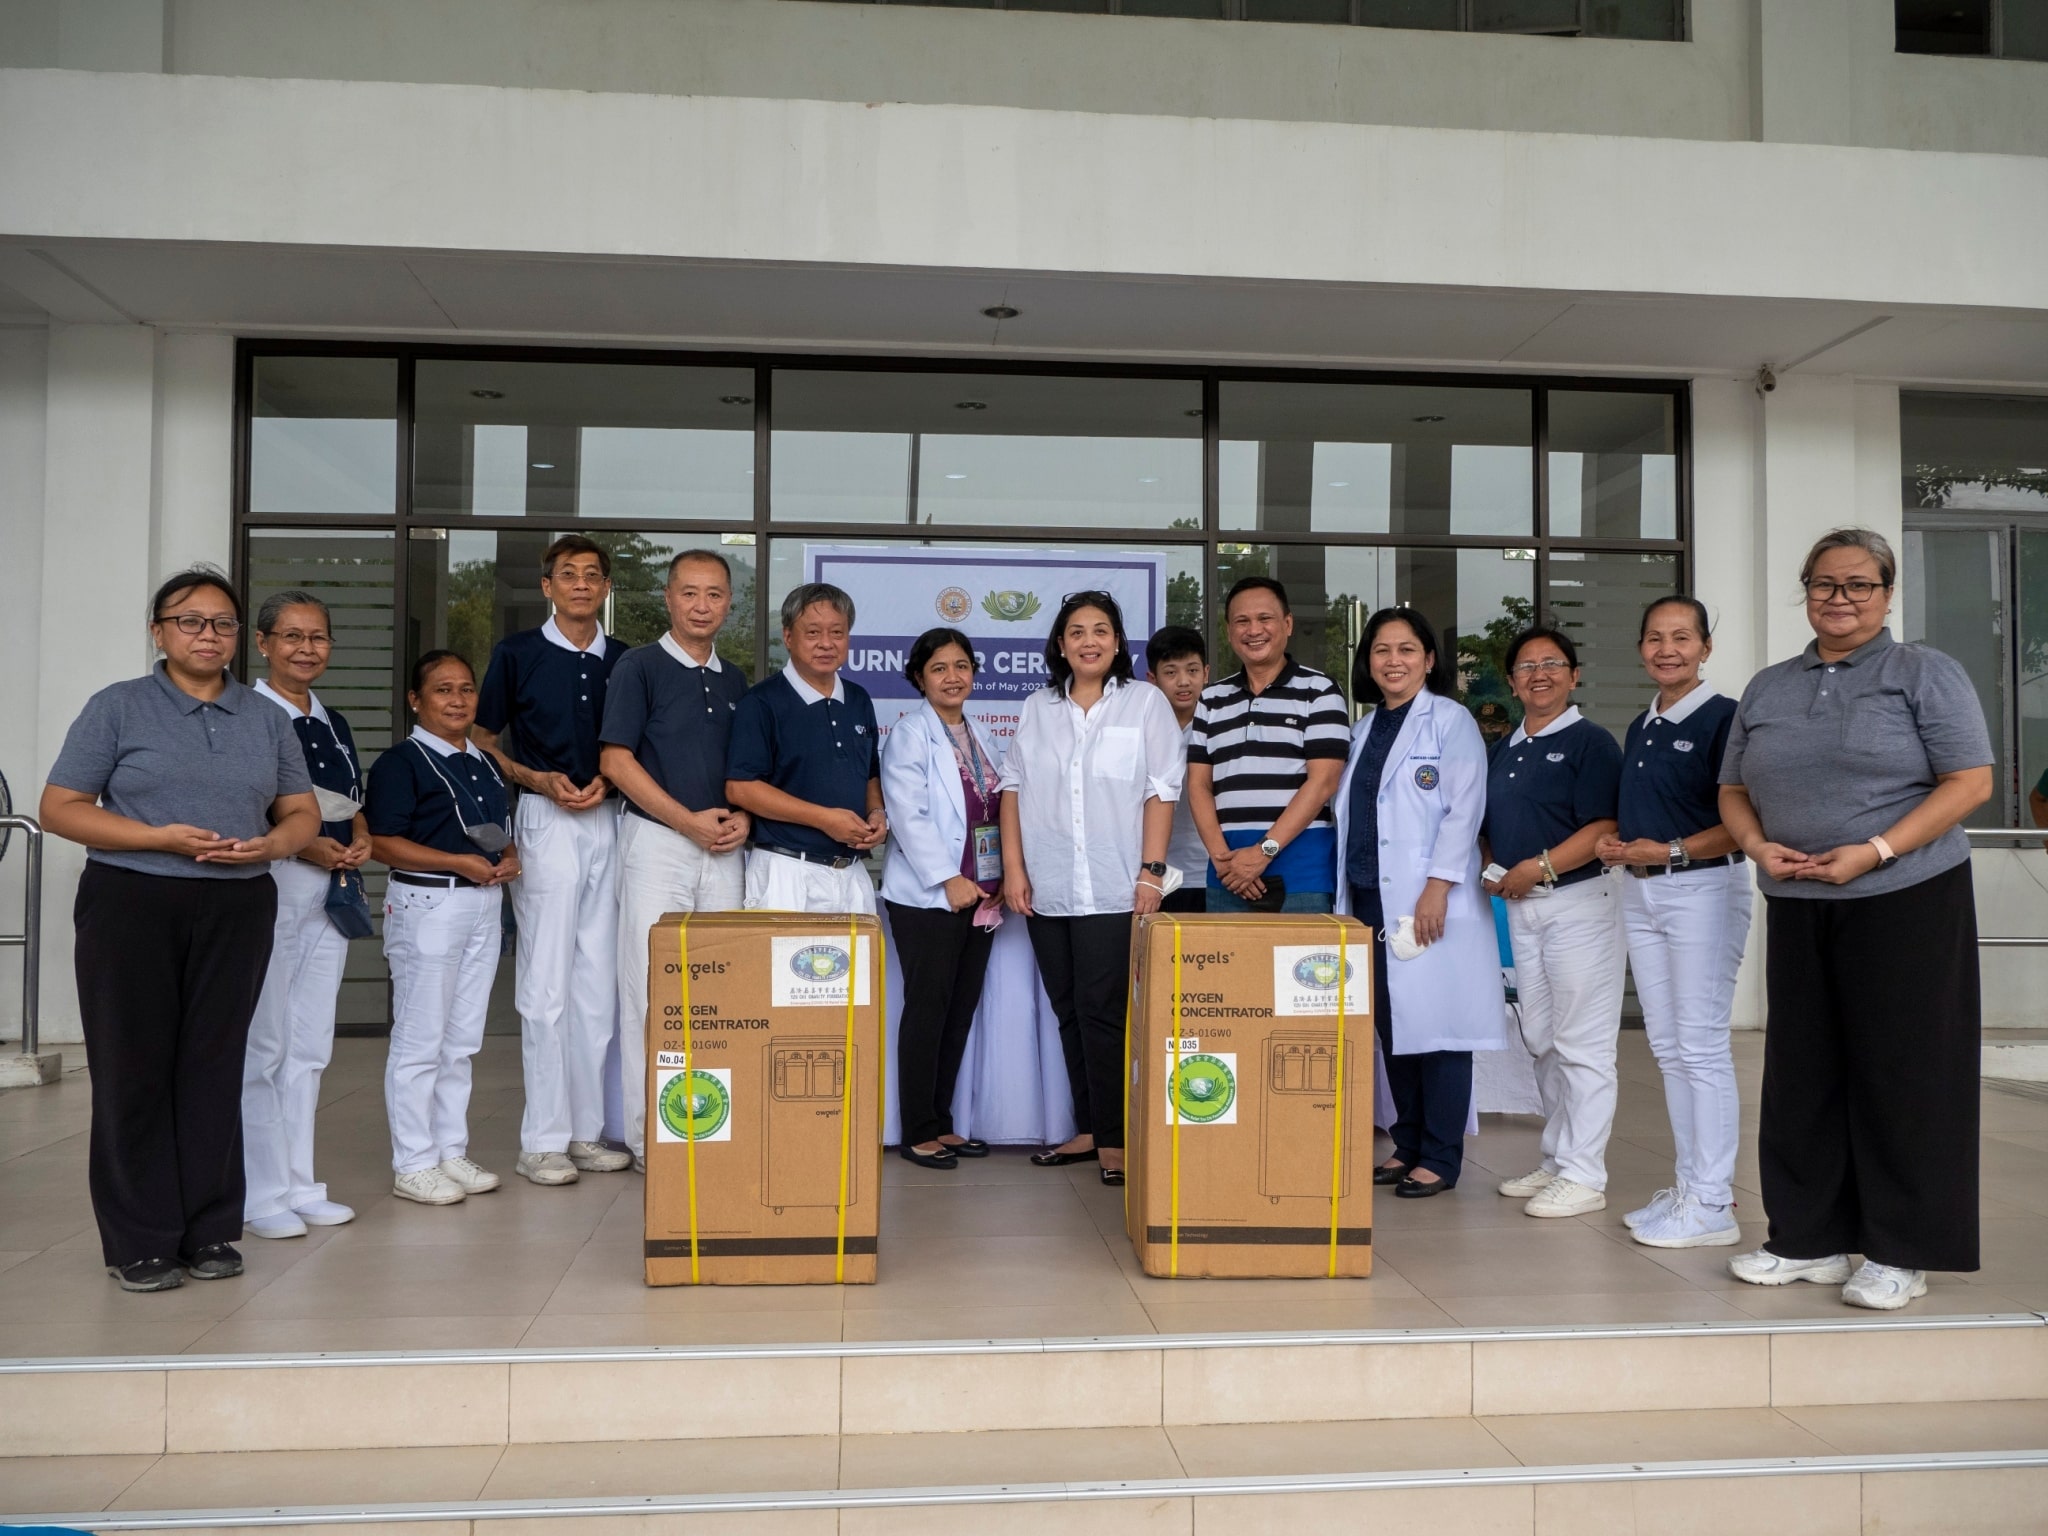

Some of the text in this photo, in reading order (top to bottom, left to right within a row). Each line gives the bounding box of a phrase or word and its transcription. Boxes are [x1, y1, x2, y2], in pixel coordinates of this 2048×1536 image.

[839, 649, 909, 672] URN-
[985, 682, 996, 691] of
[998, 682, 1019, 692] May
[664, 1005, 718, 1016] OXGEN
[1168, 1040, 1197, 1050] N.035
[659, 1053, 685, 1064] No.04
